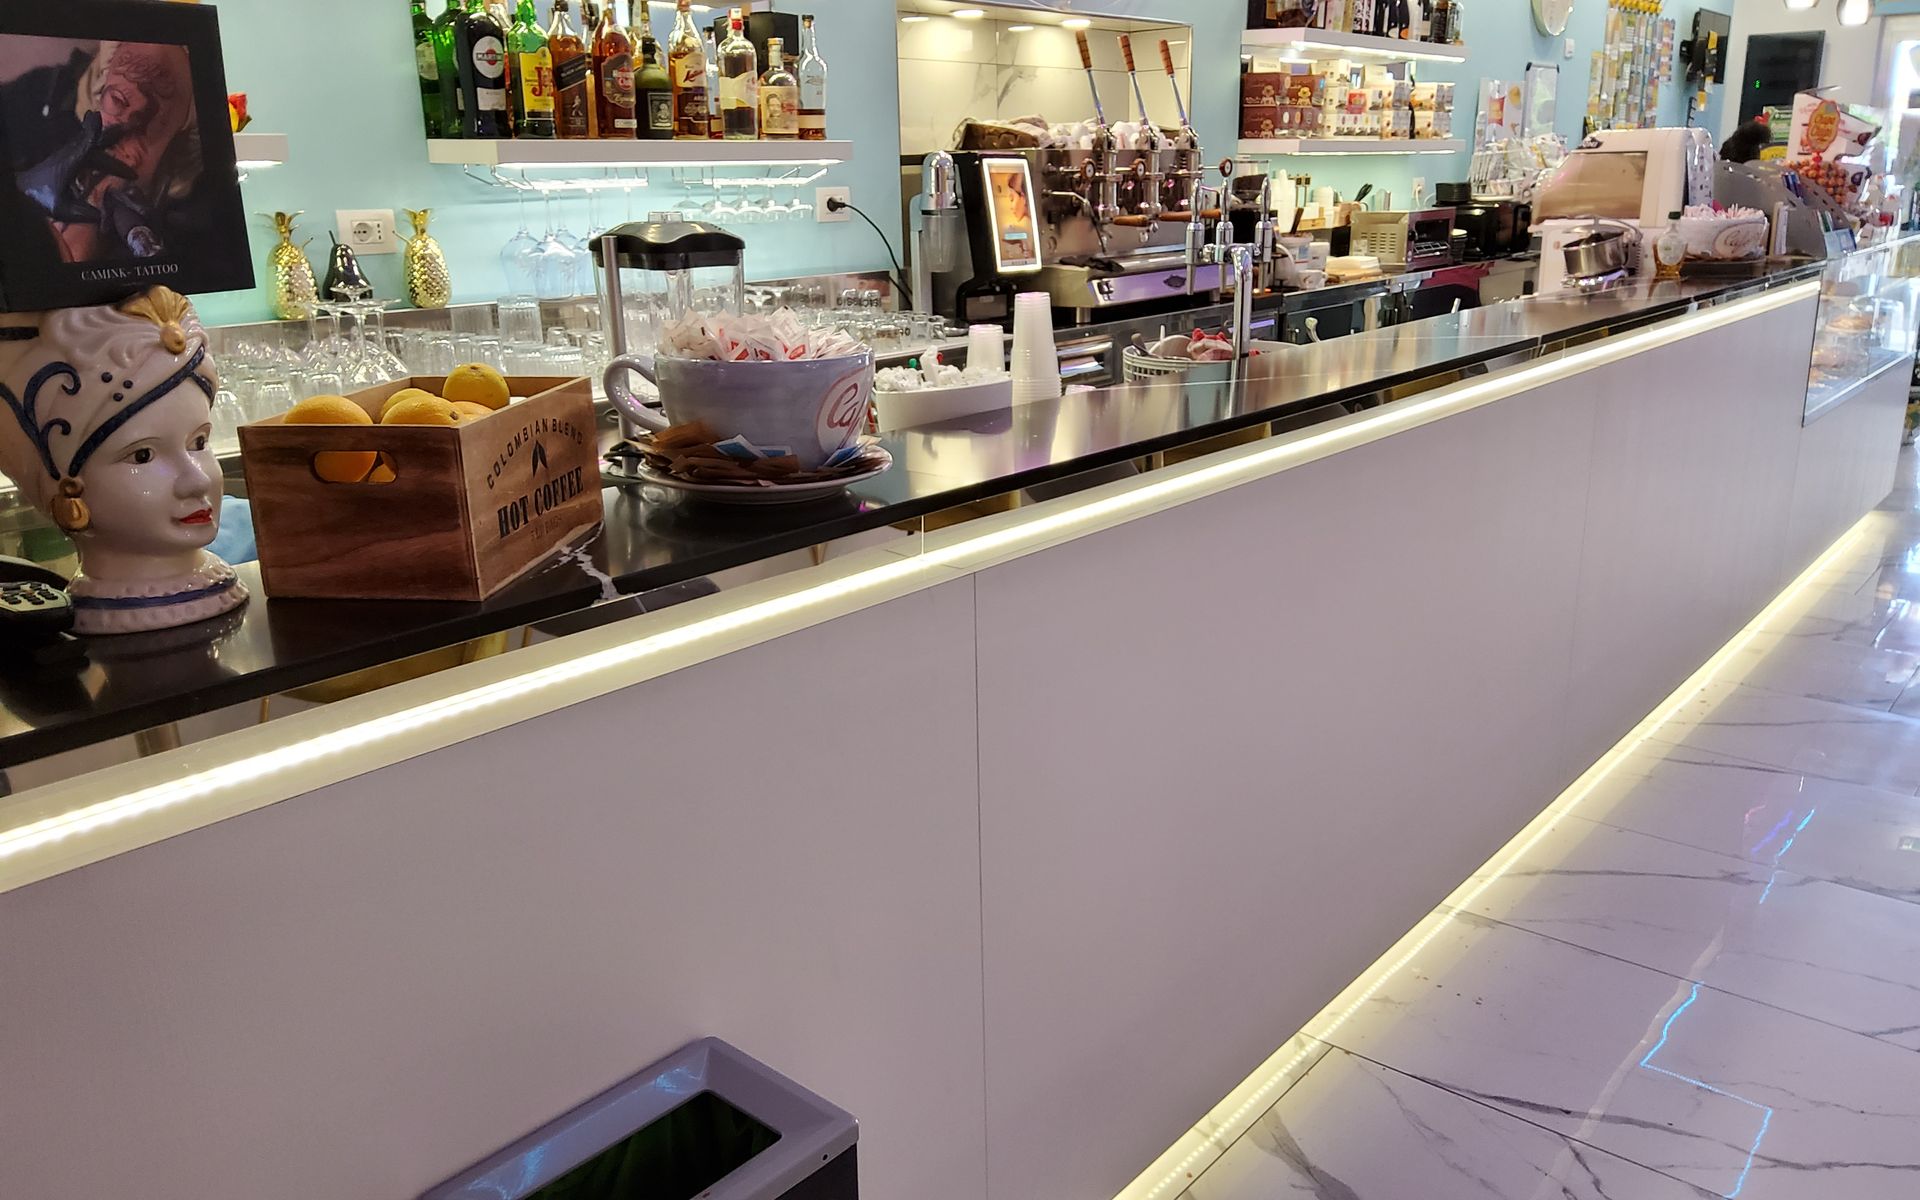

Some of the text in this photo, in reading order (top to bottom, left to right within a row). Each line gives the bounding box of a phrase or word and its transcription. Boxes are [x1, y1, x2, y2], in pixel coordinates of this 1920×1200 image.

[135, 263, 179, 277] TATTOO
[486, 418, 583, 490] COLOMBIAN BLEND
[497, 495, 530, 539] HOT
[533, 466, 585, 517] COFFEE
